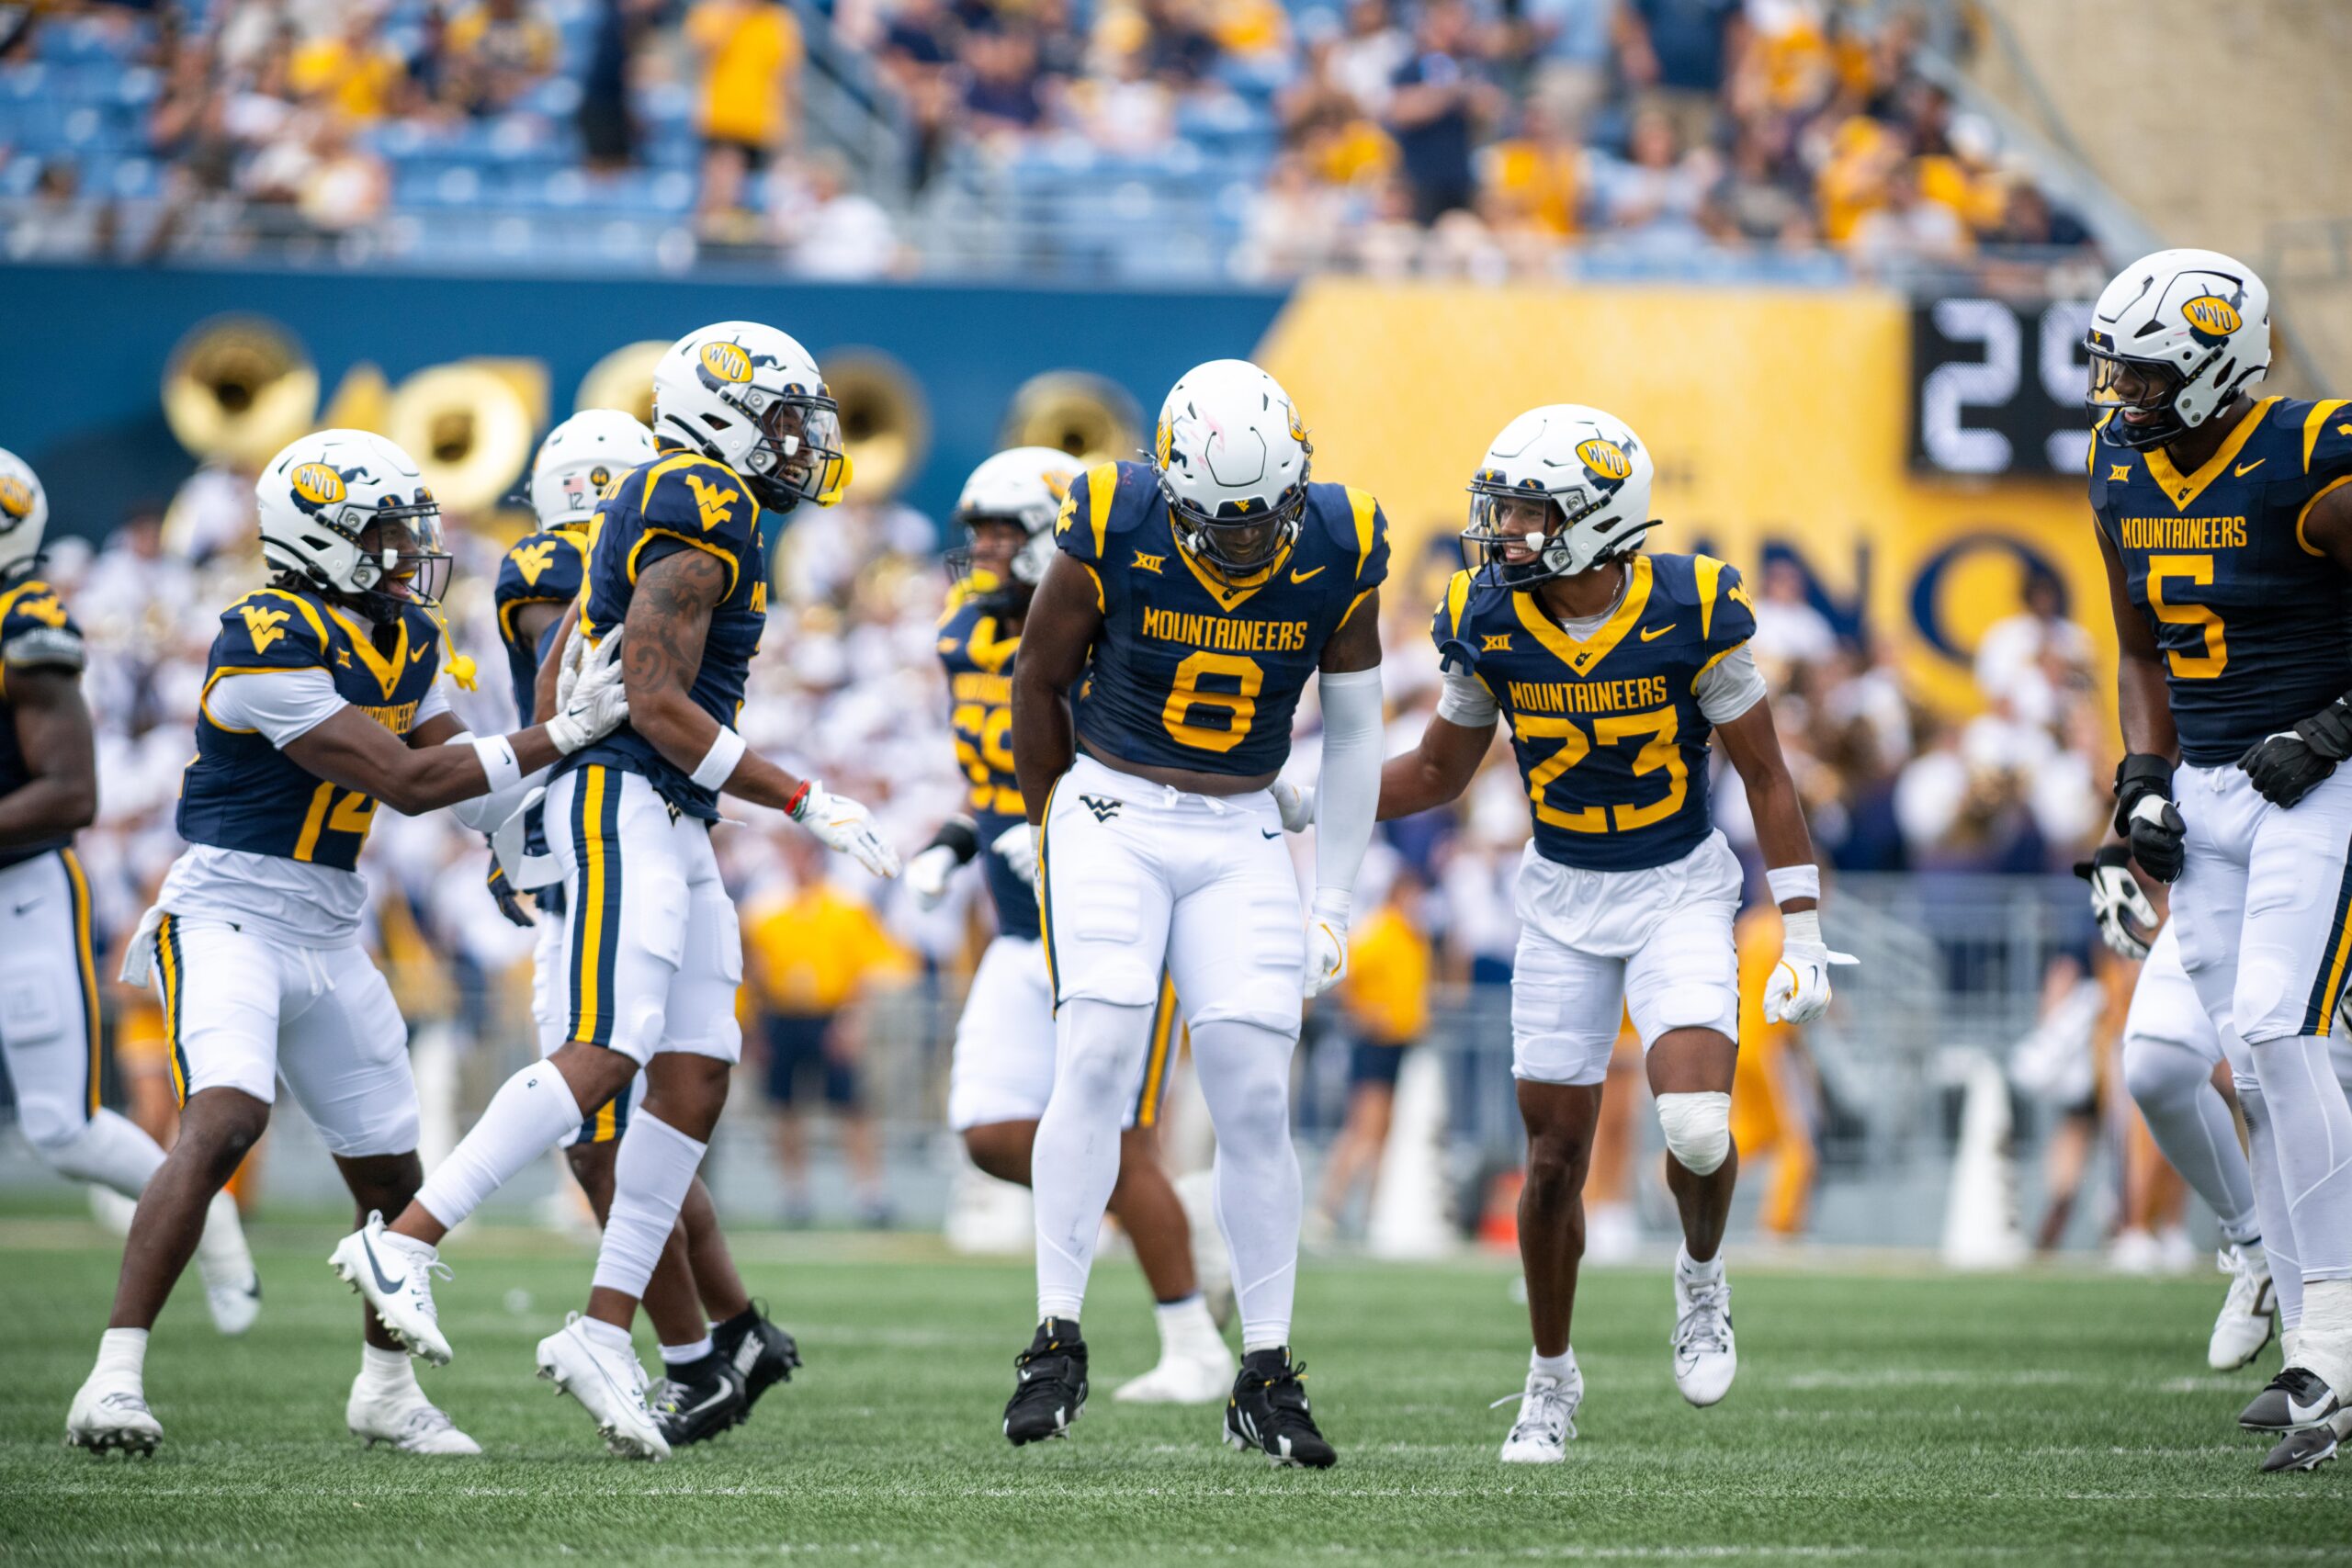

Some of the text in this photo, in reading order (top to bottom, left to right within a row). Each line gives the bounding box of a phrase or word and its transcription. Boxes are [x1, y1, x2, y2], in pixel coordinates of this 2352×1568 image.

[2191, 301, 2233, 332] WVU
[709, 344, 746, 379] WVU
[1586, 443, 1624, 476] WVU
[300, 467, 337, 501] WVU
[2120, 515, 2248, 549] MOUNTAINEERS
[1142, 605, 1308, 652] MOUNTAINEERS
[2146, 554, 2229, 679] 5
[1161, 649, 1265, 753] 8
[1508, 674, 1668, 714] MOUNTAINEERS
[1512, 703, 1690, 834] 23
